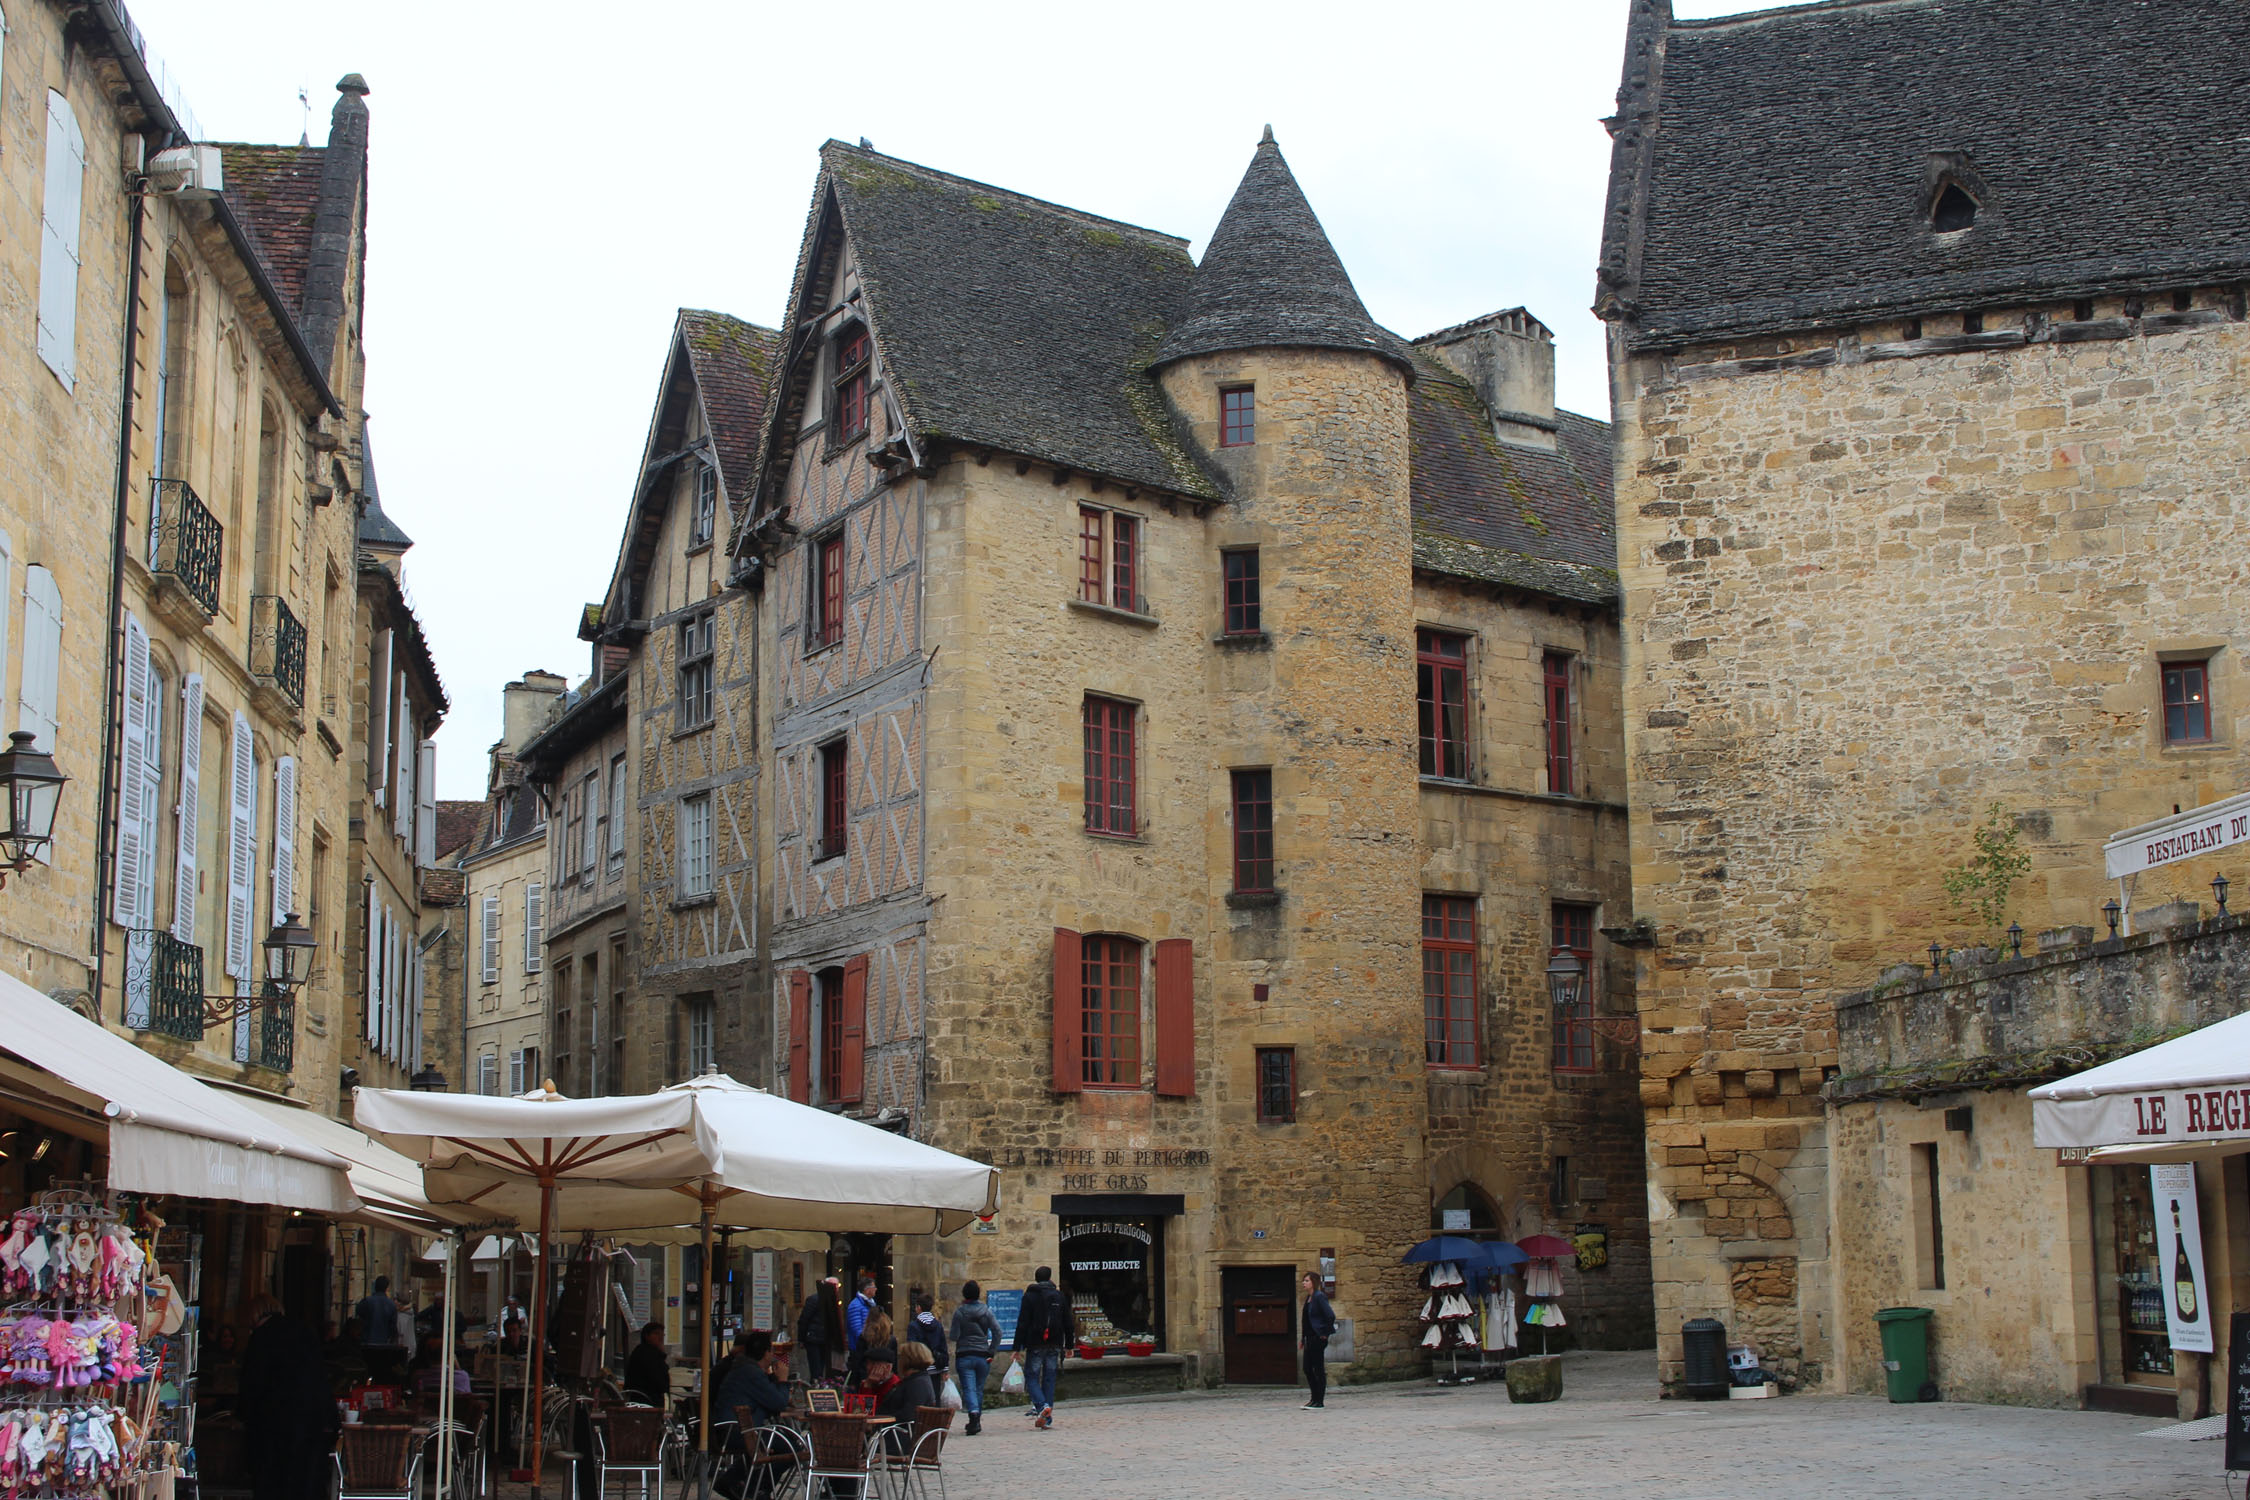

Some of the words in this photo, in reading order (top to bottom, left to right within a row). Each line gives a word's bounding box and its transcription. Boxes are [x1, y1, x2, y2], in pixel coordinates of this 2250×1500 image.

[2146, 824, 2222, 864] RESTAURANT
[2230, 815, 2247, 840] DU
[2133, 1096, 2167, 1135] LE
[1006, 1149, 1026, 1166] LA
[1037, 1149, 1096, 1166] TRUFFE
[1105, 1150, 1125, 1166] DU
[1135, 1149, 1210, 1166] PERIGORD
[1063, 1174, 1097, 1191] FOIE
[1107, 1174, 1148, 1191] GRAS
[1060, 1227, 1071, 1242] LA
[1072, 1222, 1100, 1237] TRUFFE
[1102, 1222, 1113, 1233] DU
[1114, 1223, 1152, 1246] PERIGORD
[1070, 1261, 1100, 1271] VENTE
[1102, 1260, 1140, 1270] DIRECTE
